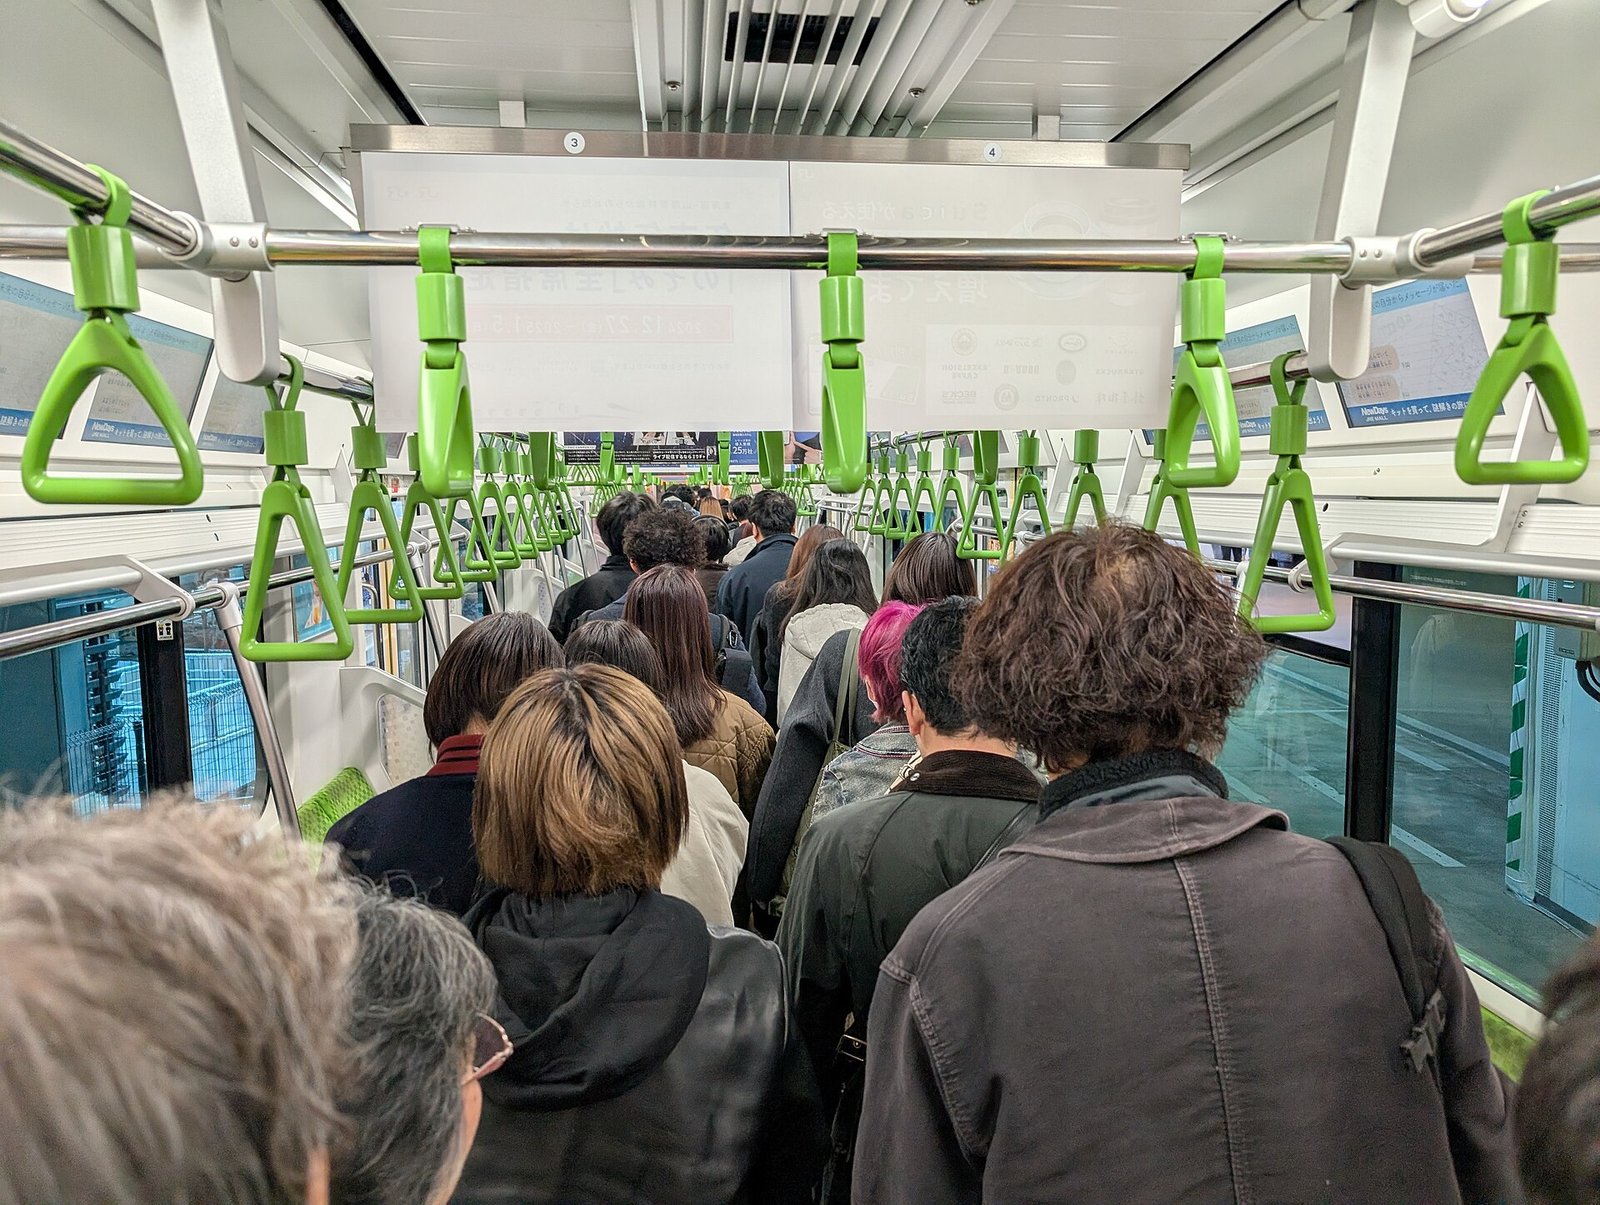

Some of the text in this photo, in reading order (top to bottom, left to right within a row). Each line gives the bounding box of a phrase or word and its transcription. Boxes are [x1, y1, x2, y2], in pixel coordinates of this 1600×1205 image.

[570, 137, 579, 148] 3
[988, 147, 996, 157] 4
[732, 446, 753, 455] 25万社
